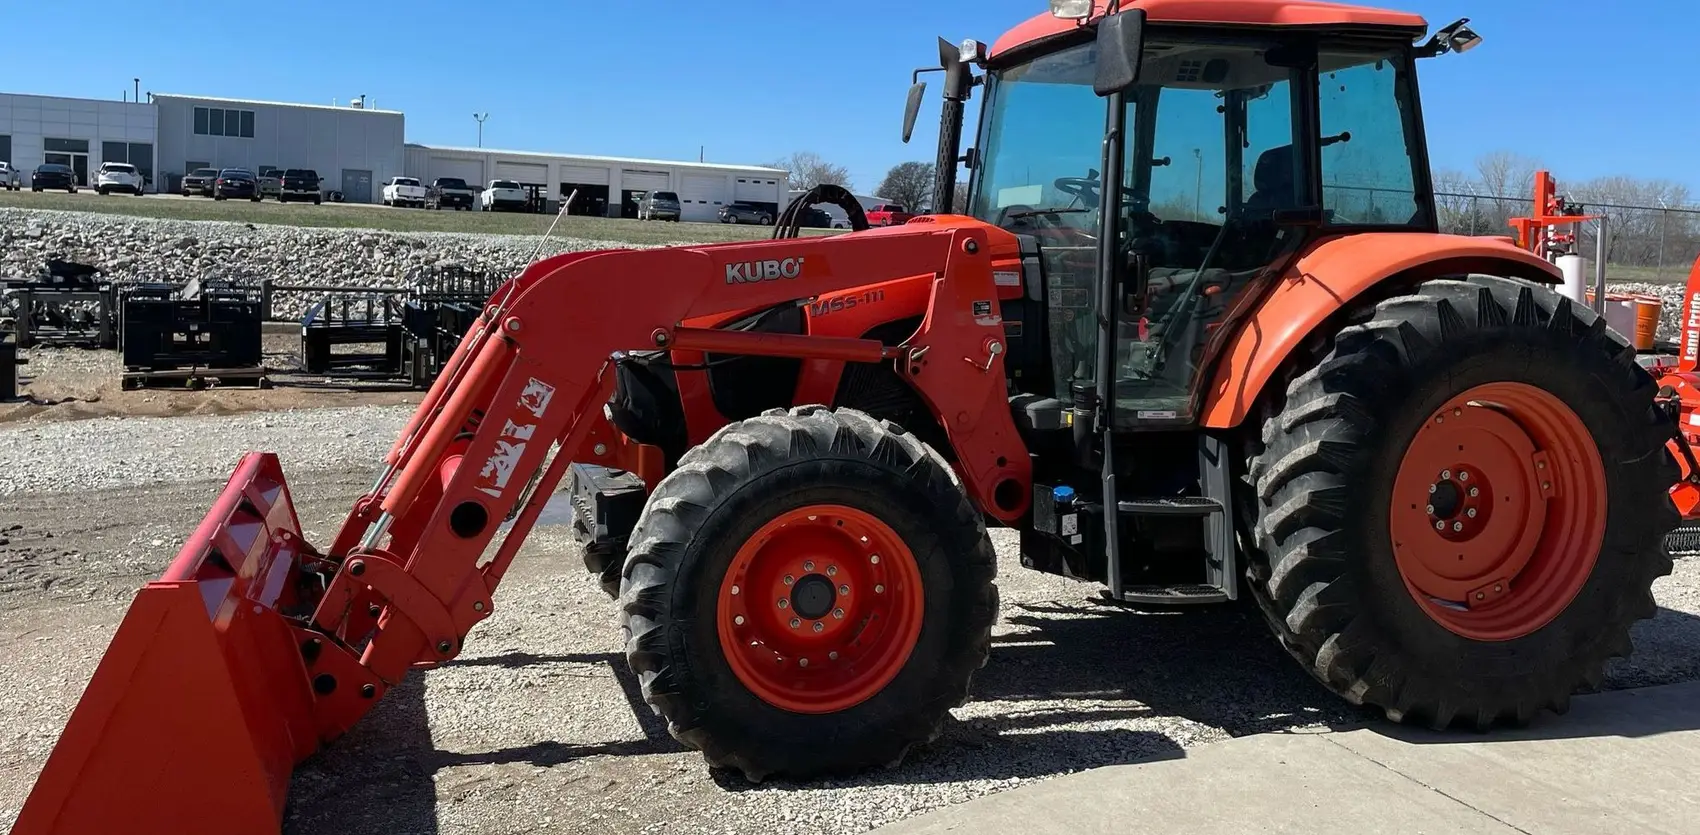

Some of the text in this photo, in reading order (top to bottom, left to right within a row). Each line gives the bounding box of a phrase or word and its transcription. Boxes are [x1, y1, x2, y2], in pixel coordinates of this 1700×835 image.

[726, 257, 804, 284] KUBO
[811, 290, 885, 317] M6S-111
[1684, 292, 1700, 361] Land Pride
